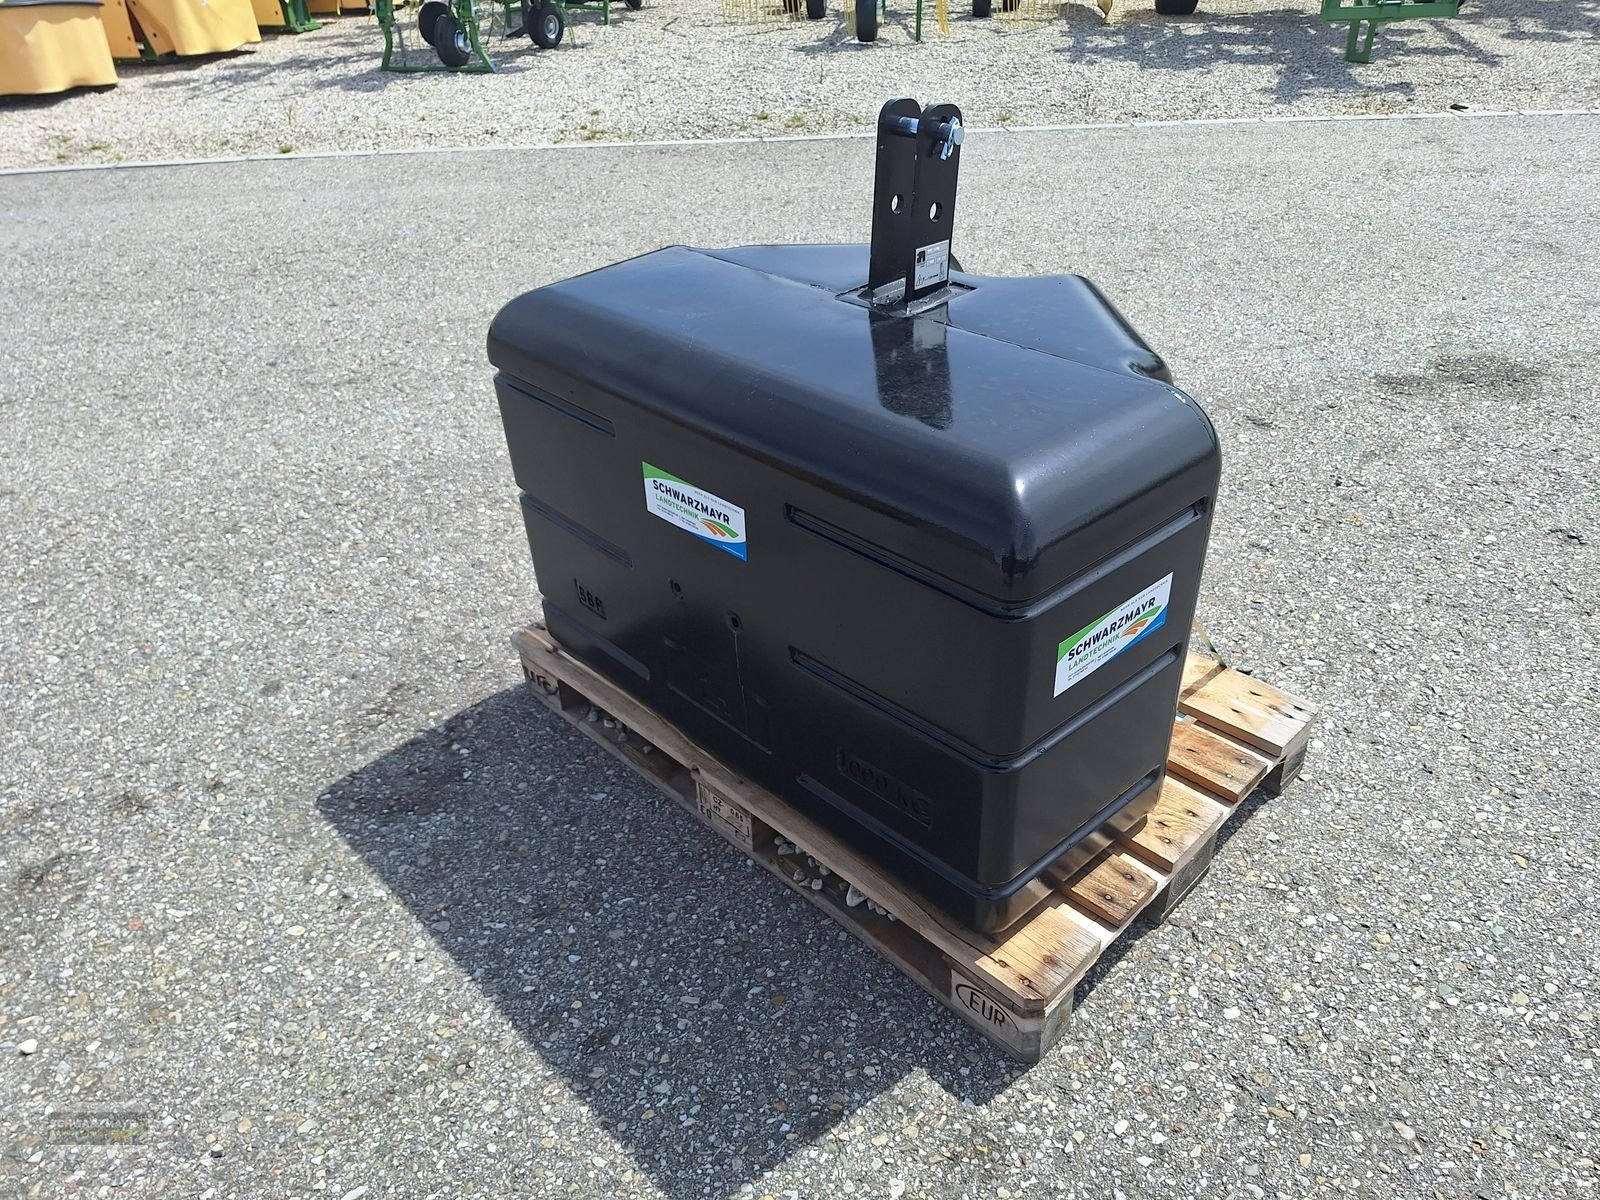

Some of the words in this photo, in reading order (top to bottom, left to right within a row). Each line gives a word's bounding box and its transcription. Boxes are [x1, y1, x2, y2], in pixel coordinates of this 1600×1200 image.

[652, 479, 730, 526] SCHWARZMAYR
[655, 493, 700, 521] LANDTECHNIK
[1067, 596, 1156, 662] SCHWARZMAYR
[1068, 632, 1120, 672] LANDTECHNIK
[969, 990, 1006, 1027] EUR
